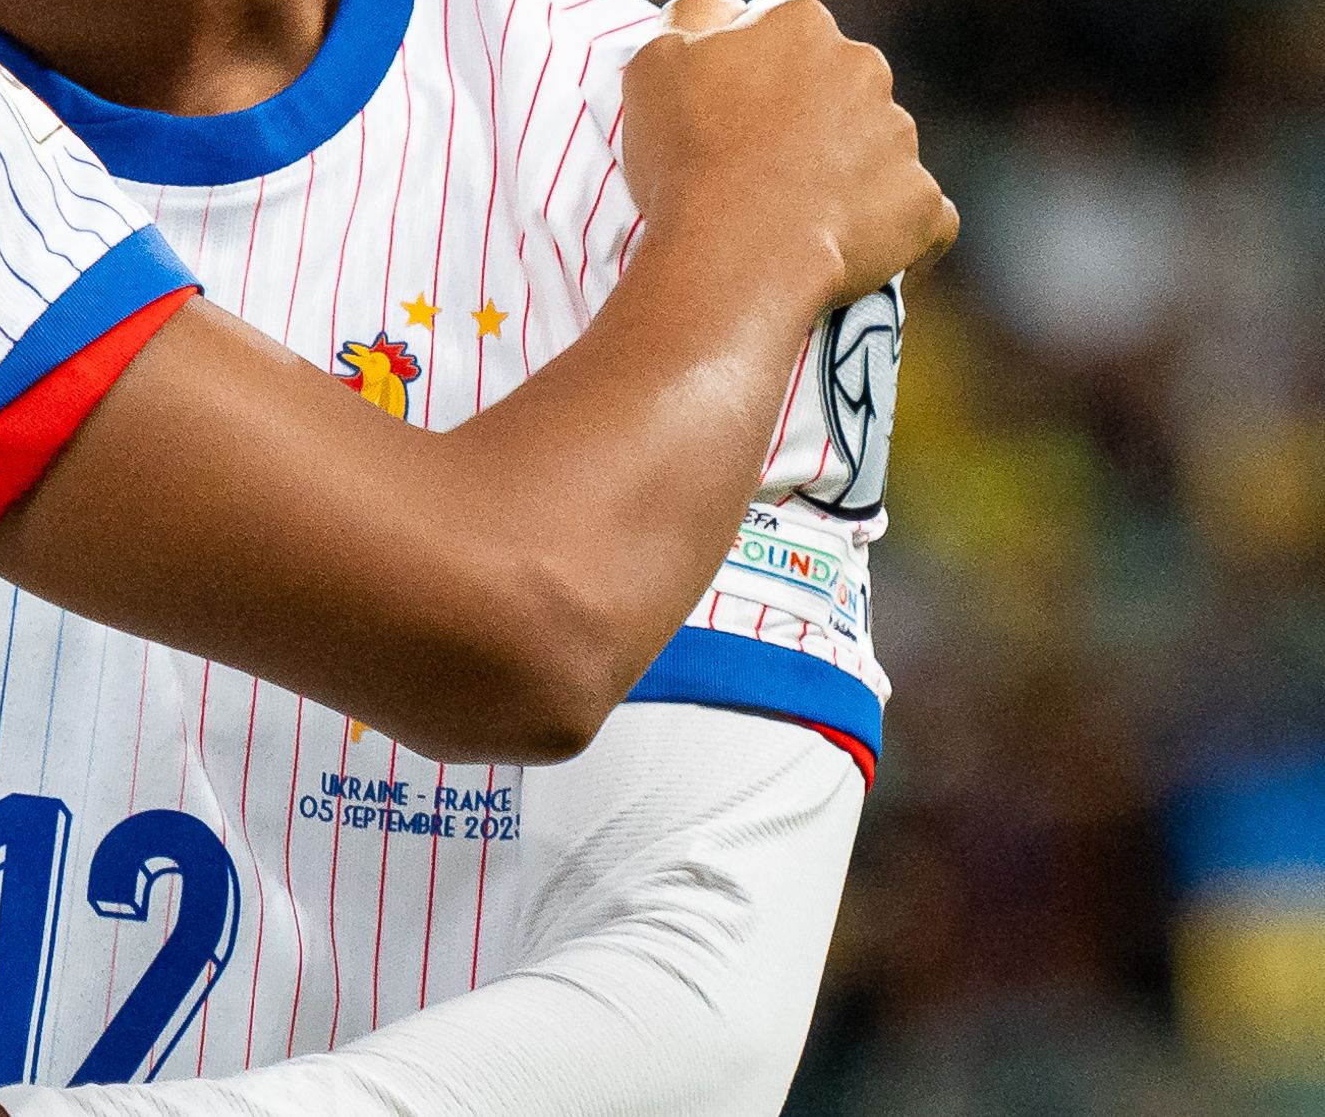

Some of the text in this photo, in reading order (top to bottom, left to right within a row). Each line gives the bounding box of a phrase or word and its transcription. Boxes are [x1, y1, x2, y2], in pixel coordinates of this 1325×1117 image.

[743, 507, 780, 532] EFA
[321, 771, 410, 806] UKRAINE
[433, 786, 512, 813] FRANCE
[299, 795, 334, 822] 05
[341, 804, 457, 838] SEPTEMBRE
